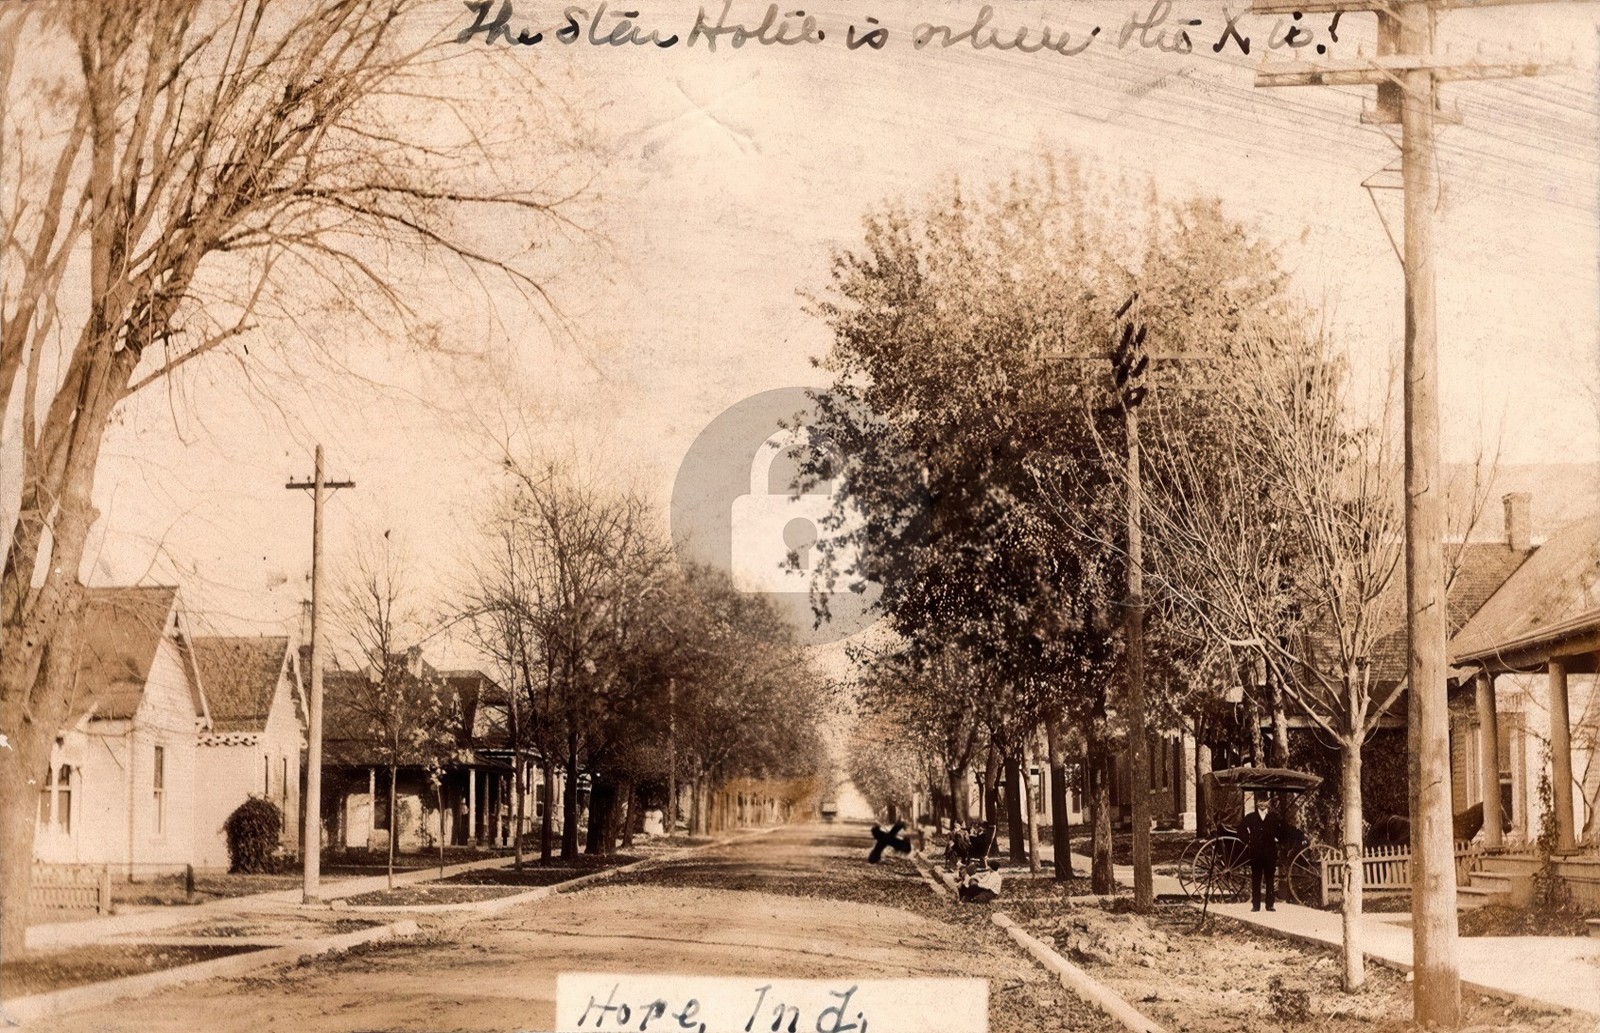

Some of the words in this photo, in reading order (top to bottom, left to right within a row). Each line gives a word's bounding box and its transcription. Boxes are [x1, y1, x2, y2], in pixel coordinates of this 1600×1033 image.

[457, 0, 543, 45] The
[846, 16, 889, 50] is
[912, 4, 1101, 56] where
[1213, 6, 1250, 55] X
